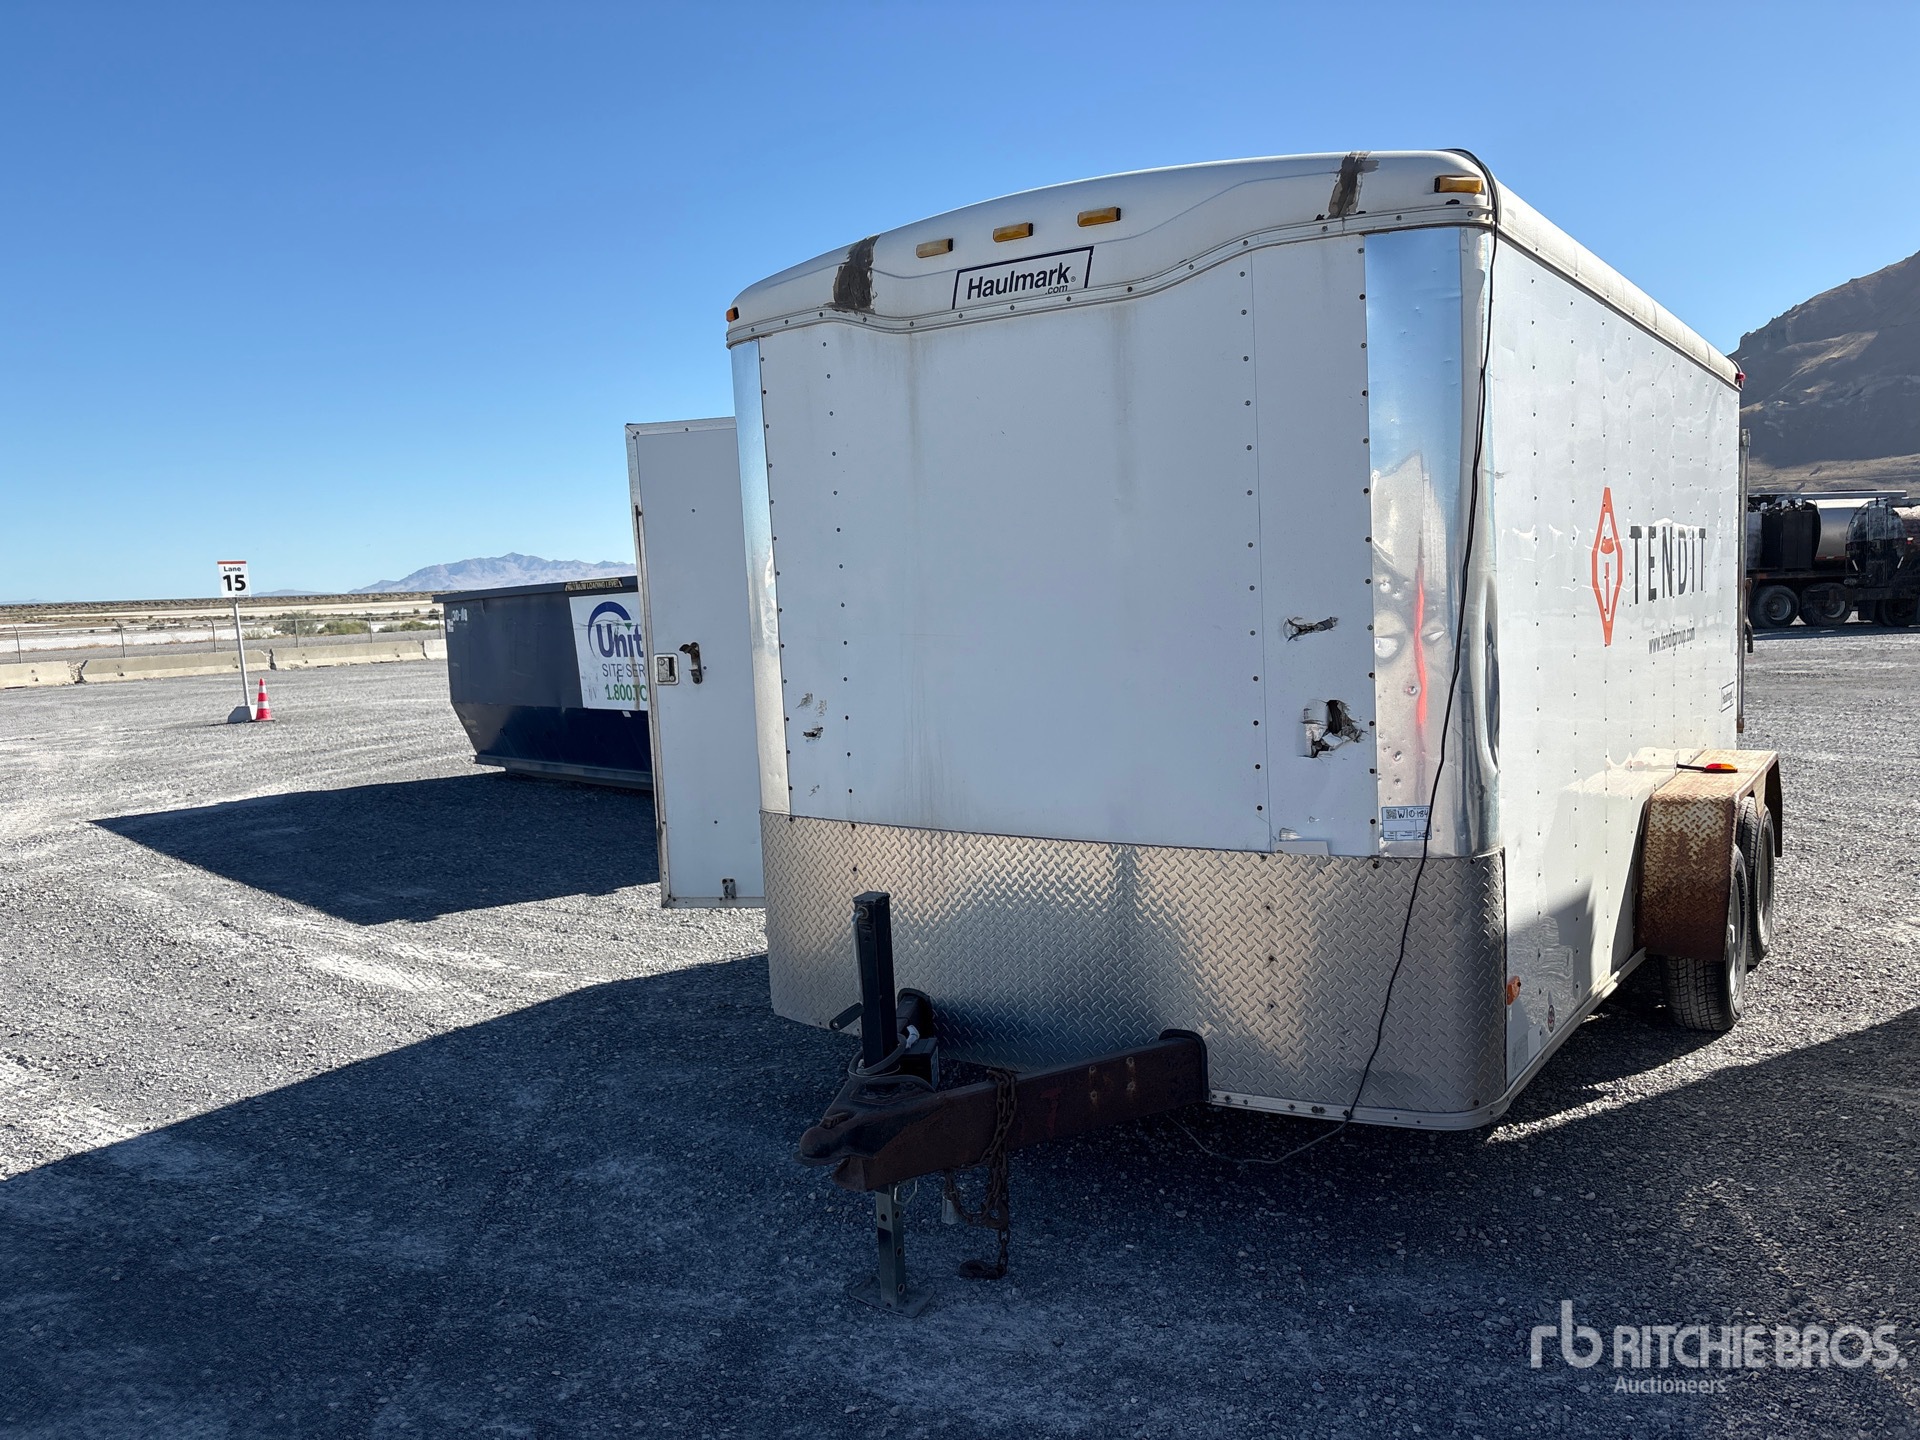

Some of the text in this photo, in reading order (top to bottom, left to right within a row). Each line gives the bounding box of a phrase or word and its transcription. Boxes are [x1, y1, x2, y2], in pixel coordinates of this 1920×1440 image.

[967, 262, 1072, 300] Haulmark
[1045, 284, 1068, 295] .com
[1630, 526, 1706, 604] TENDIT
[222, 574, 247, 592] 15
[595, 623, 645, 658] Unit
[602, 663, 646, 678] SITE SER
